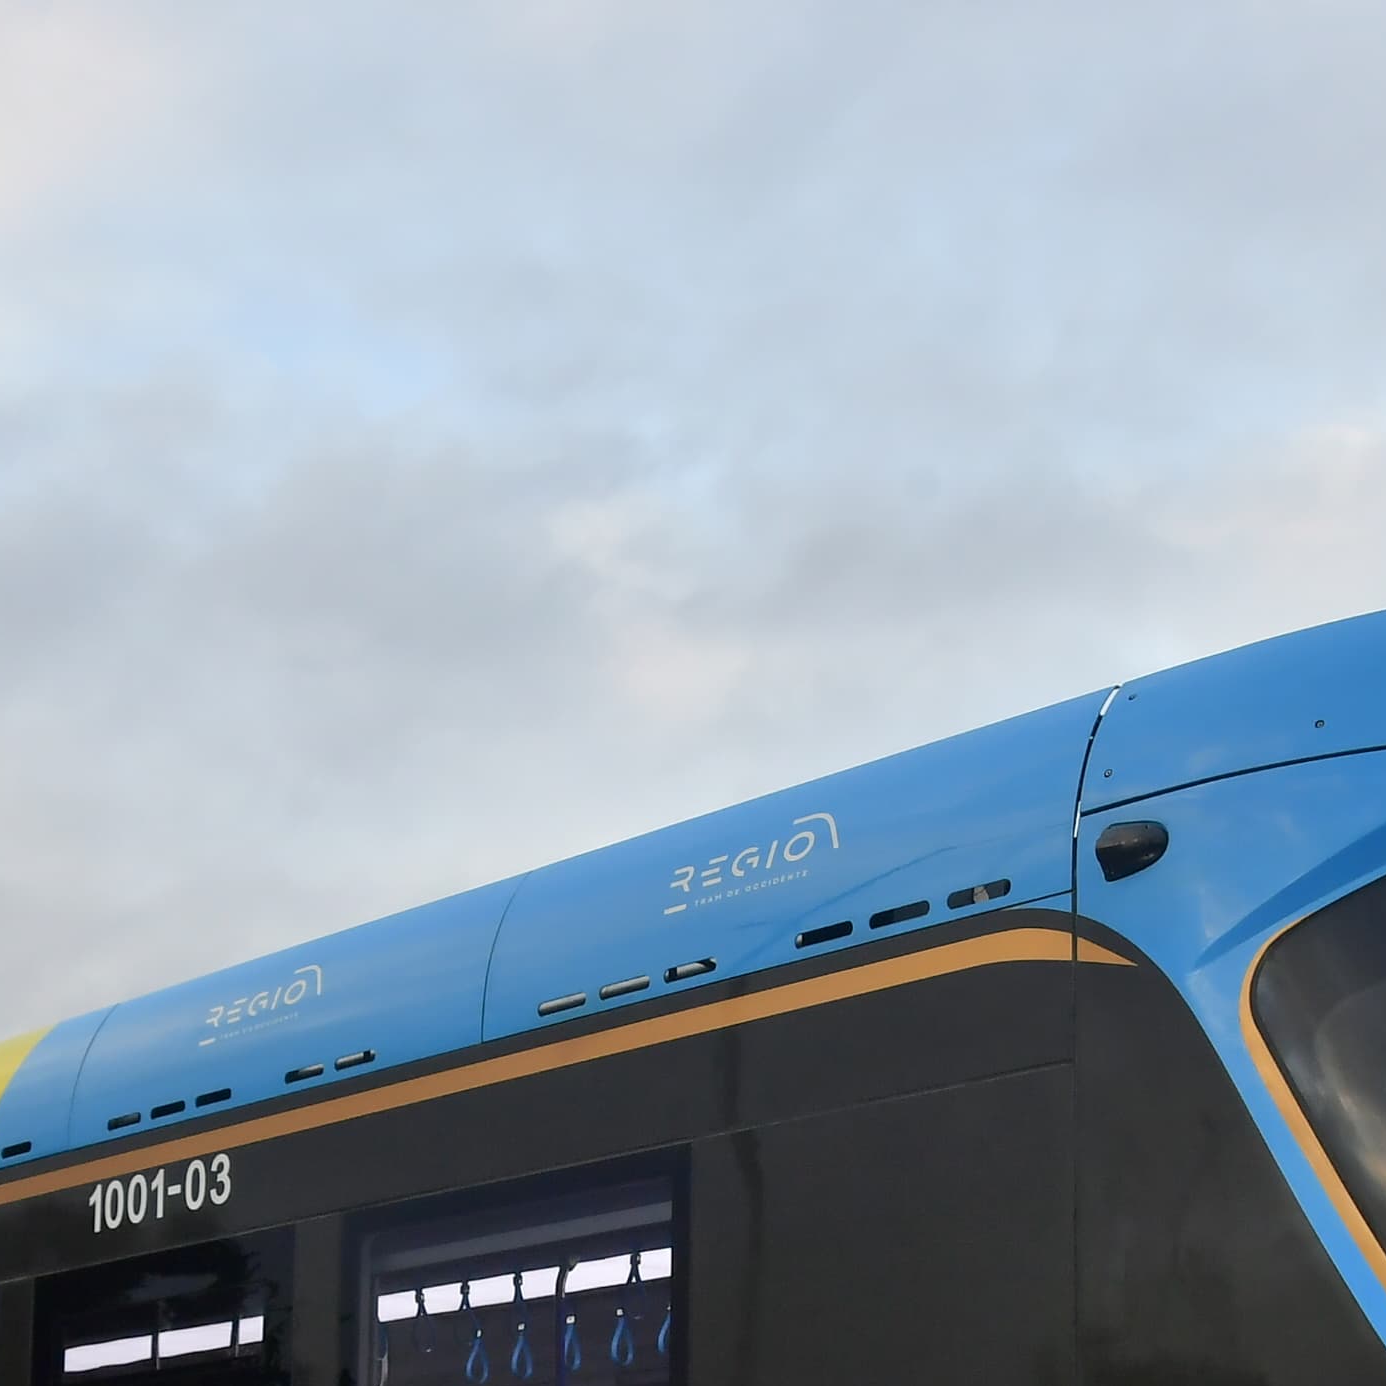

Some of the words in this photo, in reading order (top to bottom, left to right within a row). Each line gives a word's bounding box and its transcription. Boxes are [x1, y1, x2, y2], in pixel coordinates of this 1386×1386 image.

[669, 830, 816, 893] REGIO
[205, 979, 307, 1027] REGIO
[88, 1153, 231, 1233] 1001-03
